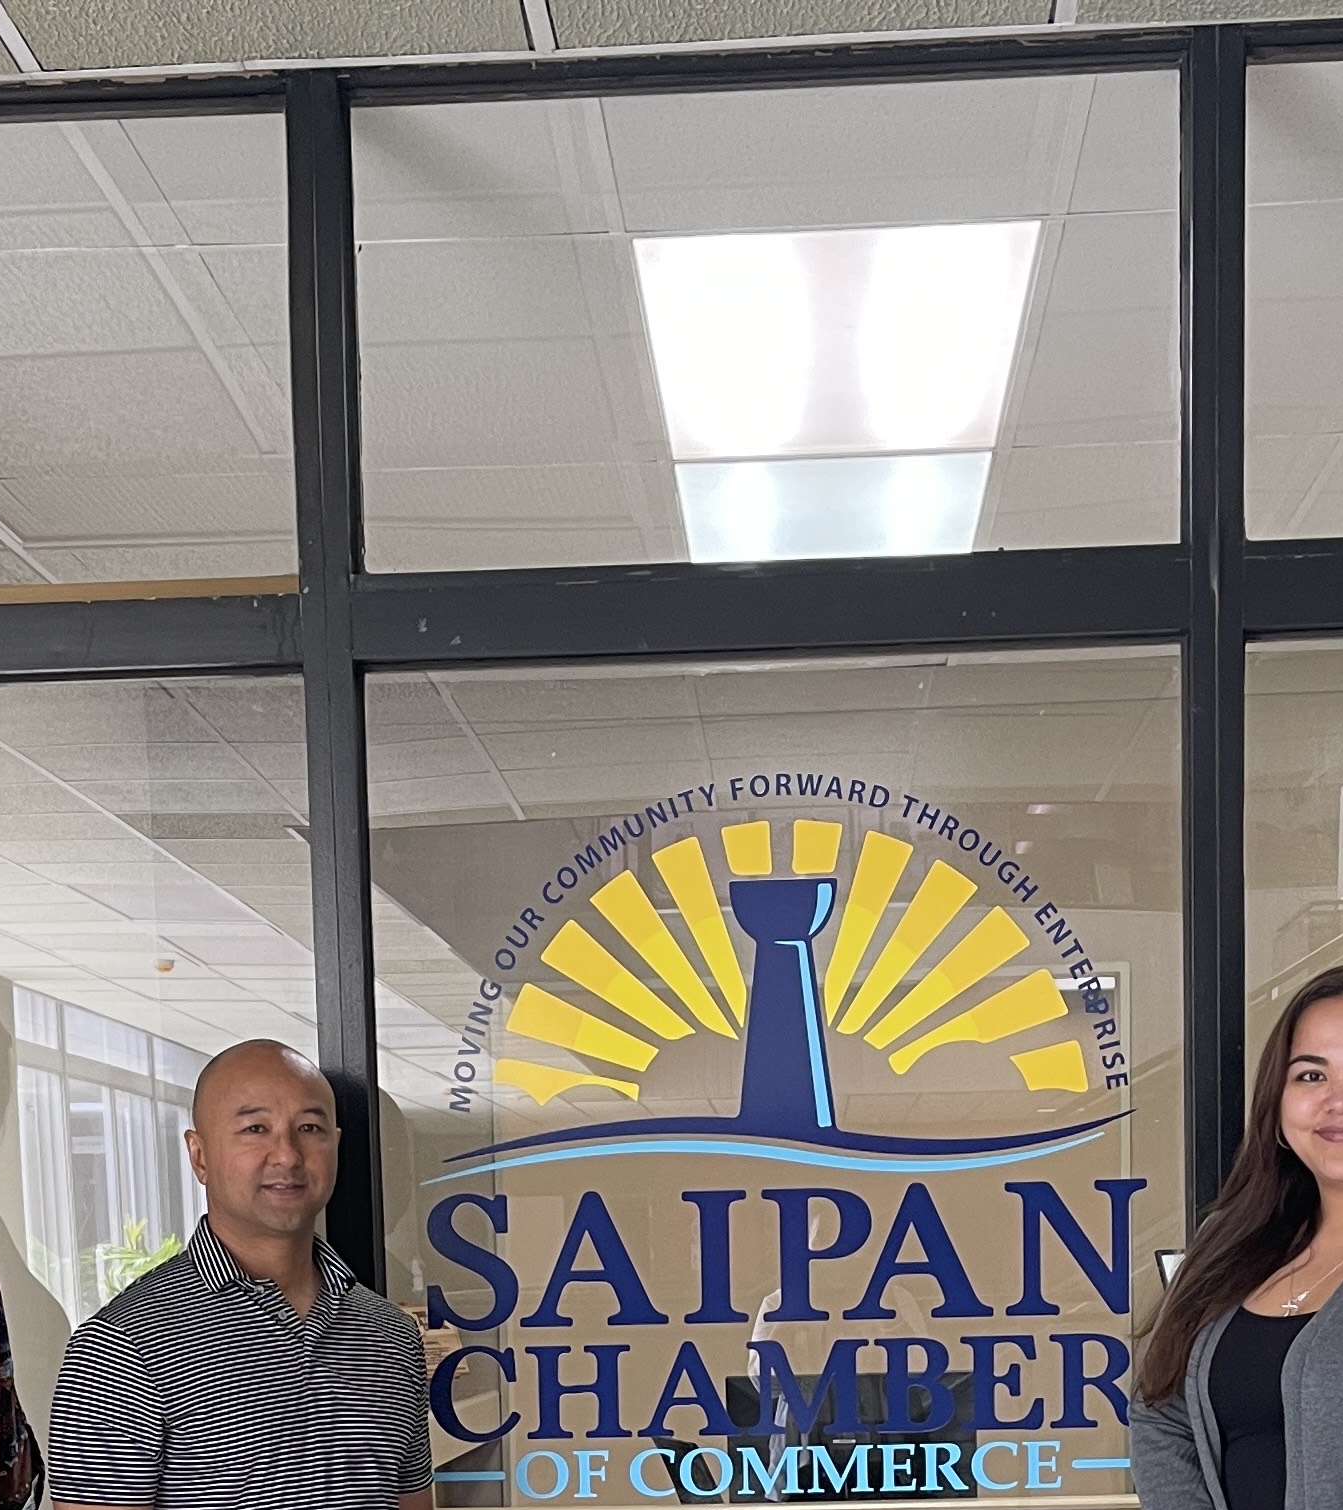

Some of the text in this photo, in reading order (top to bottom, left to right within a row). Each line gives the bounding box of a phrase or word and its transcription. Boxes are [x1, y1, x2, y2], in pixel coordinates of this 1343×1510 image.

[449, 773, 1129, 1113] MOVING OUR COMMUNITY FORWARD THROUGH ENTERPRISE
[427, 1178, 1147, 1331] SAIPAN
[428, 1333, 1131, 1442] CHAMBER
[515, 1440, 1063, 1499] OF COMMERCE
